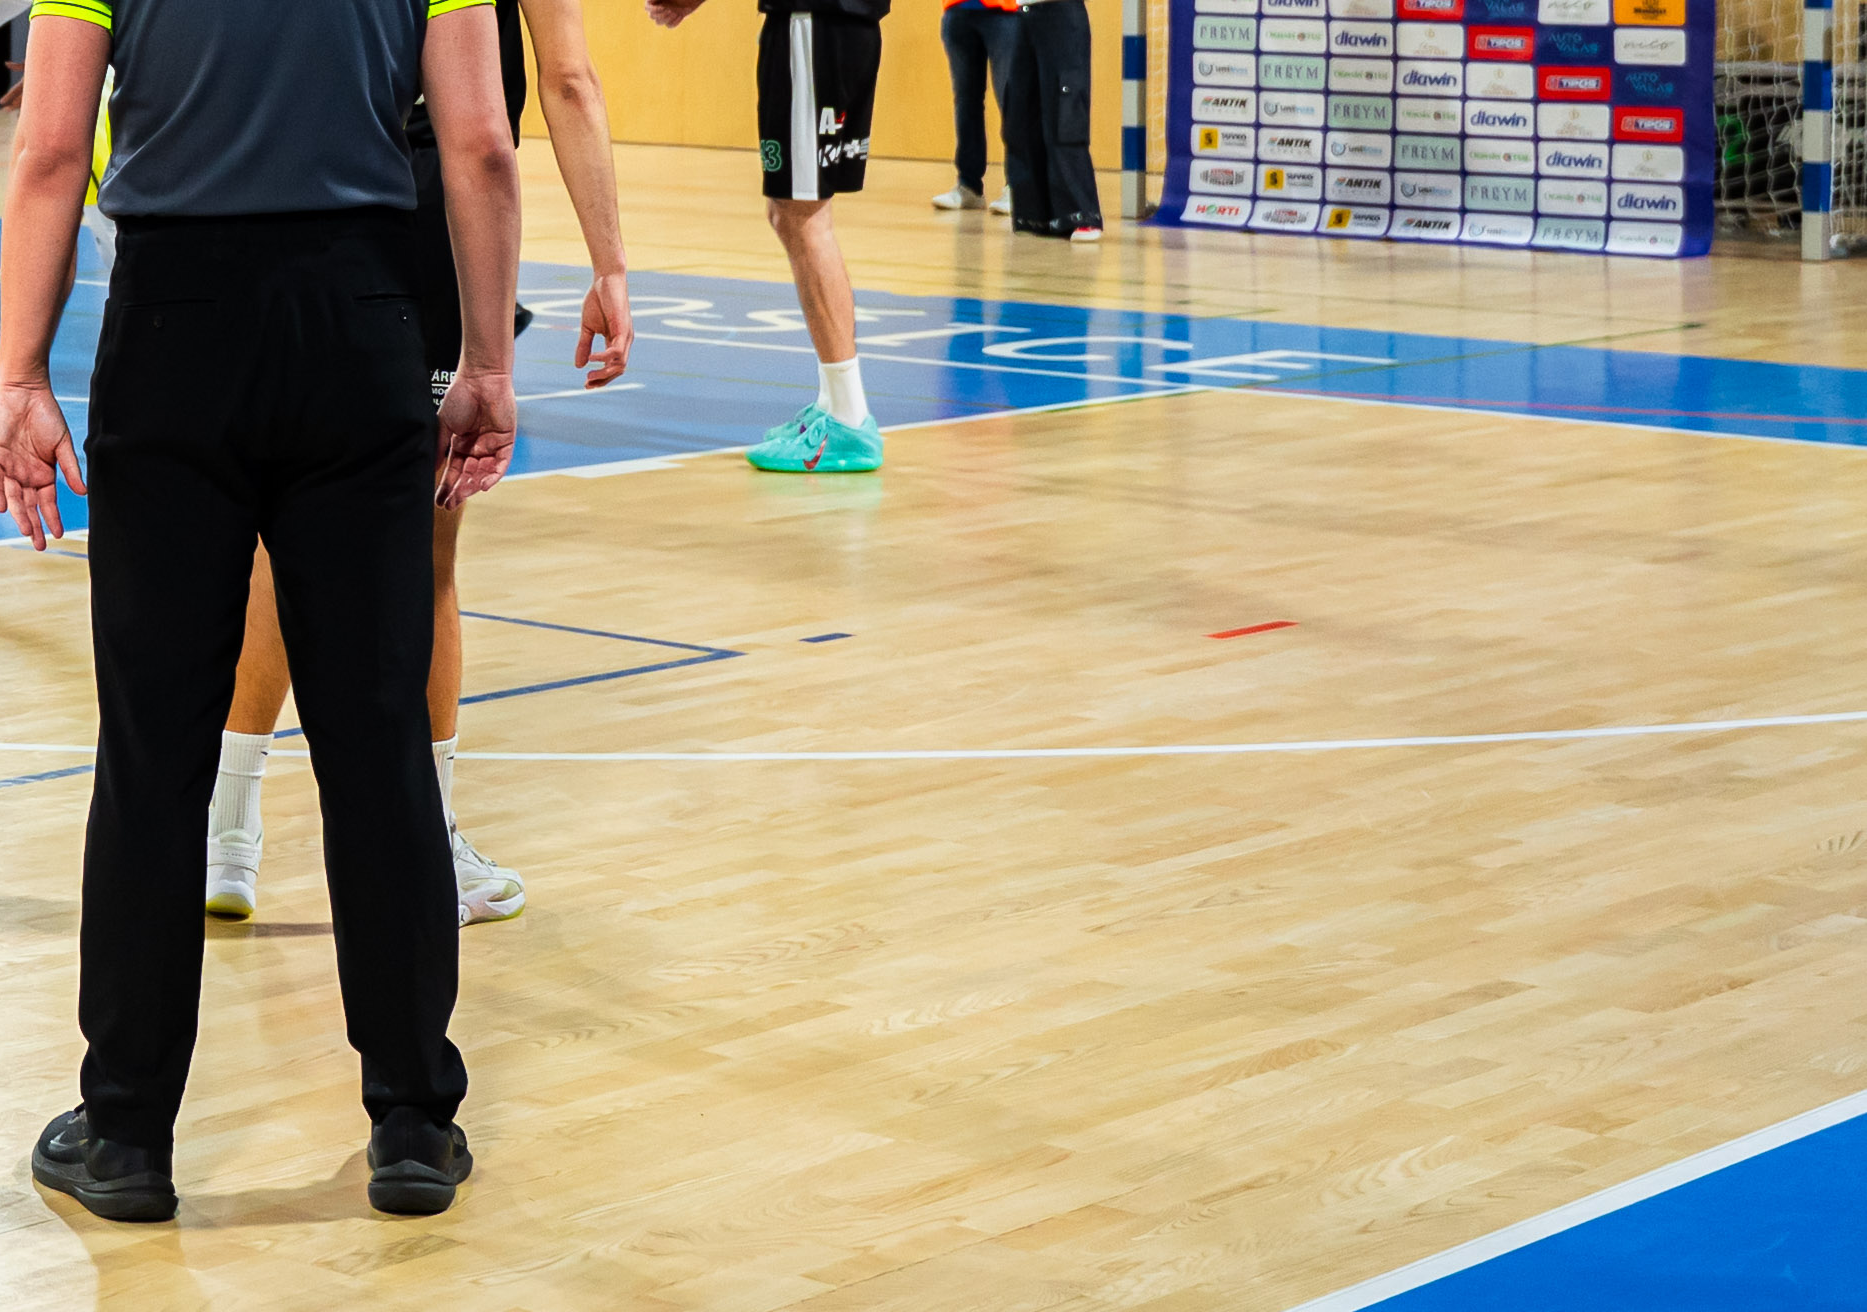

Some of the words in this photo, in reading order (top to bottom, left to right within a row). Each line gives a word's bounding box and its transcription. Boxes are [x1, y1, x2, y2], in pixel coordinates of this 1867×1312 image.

[1199, 25, 1250, 41] FREYM
[1334, 31, 1387, 48] diawin
[1263, 65, 1319, 80] FREYM
[1403, 70, 1457, 86] diawin
[1211, 97, 1248, 109] ANTIK
[1333, 103, 1386, 121] FREYM
[1470, 110, 1528, 128] diawin
[1276, 137, 1312, 149] ANTIK
[1401, 143, 1455, 161] FREYM
[1545, 150, 1603, 169] diawin
[1344, 177, 1382, 189] ANTIK
[1470, 185, 1528, 201] FREYM
[1617, 192, 1677, 211] diawin
[1411, 218, 1452, 231] ANTIK
